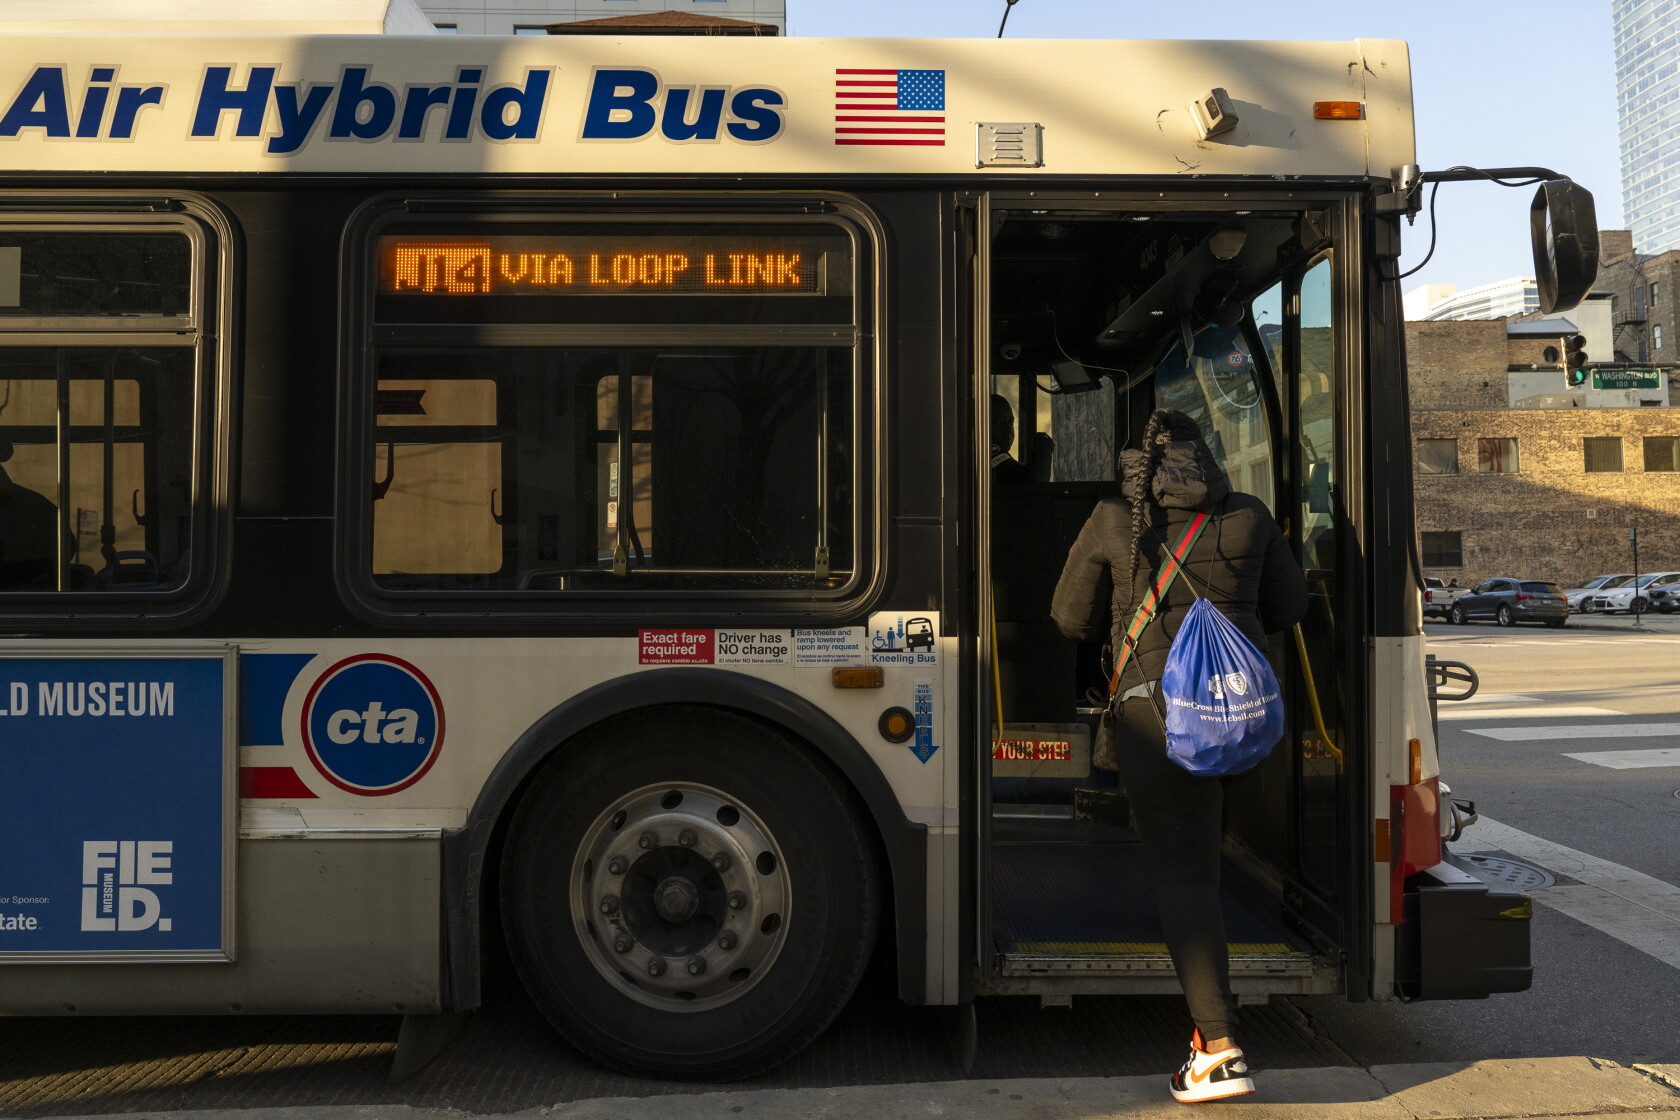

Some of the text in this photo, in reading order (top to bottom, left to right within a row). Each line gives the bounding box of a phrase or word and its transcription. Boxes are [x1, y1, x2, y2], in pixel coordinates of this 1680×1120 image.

[0, 64, 786, 155] Air Hybrid Bus
[501, 254, 573, 284] VIA
[590, 254, 689, 284] LOOP
[705, 254, 801, 284] LINK
[1601, 371, 1644, 380] WASHINGTON
[643, 632, 707, 643] Exact fare
[718, 632, 782, 643] Driver has
[796, 637, 816, 645] ramp
[642, 644, 697, 657] required
[718, 644, 788, 657] NO change
[796, 643, 859, 652] upon any request
[872, 654, 936, 664] Kneeling Bus
[38, 682, 174, 717] MUSEUM
[1173, 698, 1213, 712] BlueCross
[1229, 700, 1254, 712] Shield
[326, 701, 419, 745] cta
[919, 696, 929, 757] KNEELS
[1001, 741, 1034, 759] YOUR
[1038, 741, 1069, 759] STEP
[102, 873, 114, 913] MUSEUM
[12, 896, 50, 905] Sponsor:
